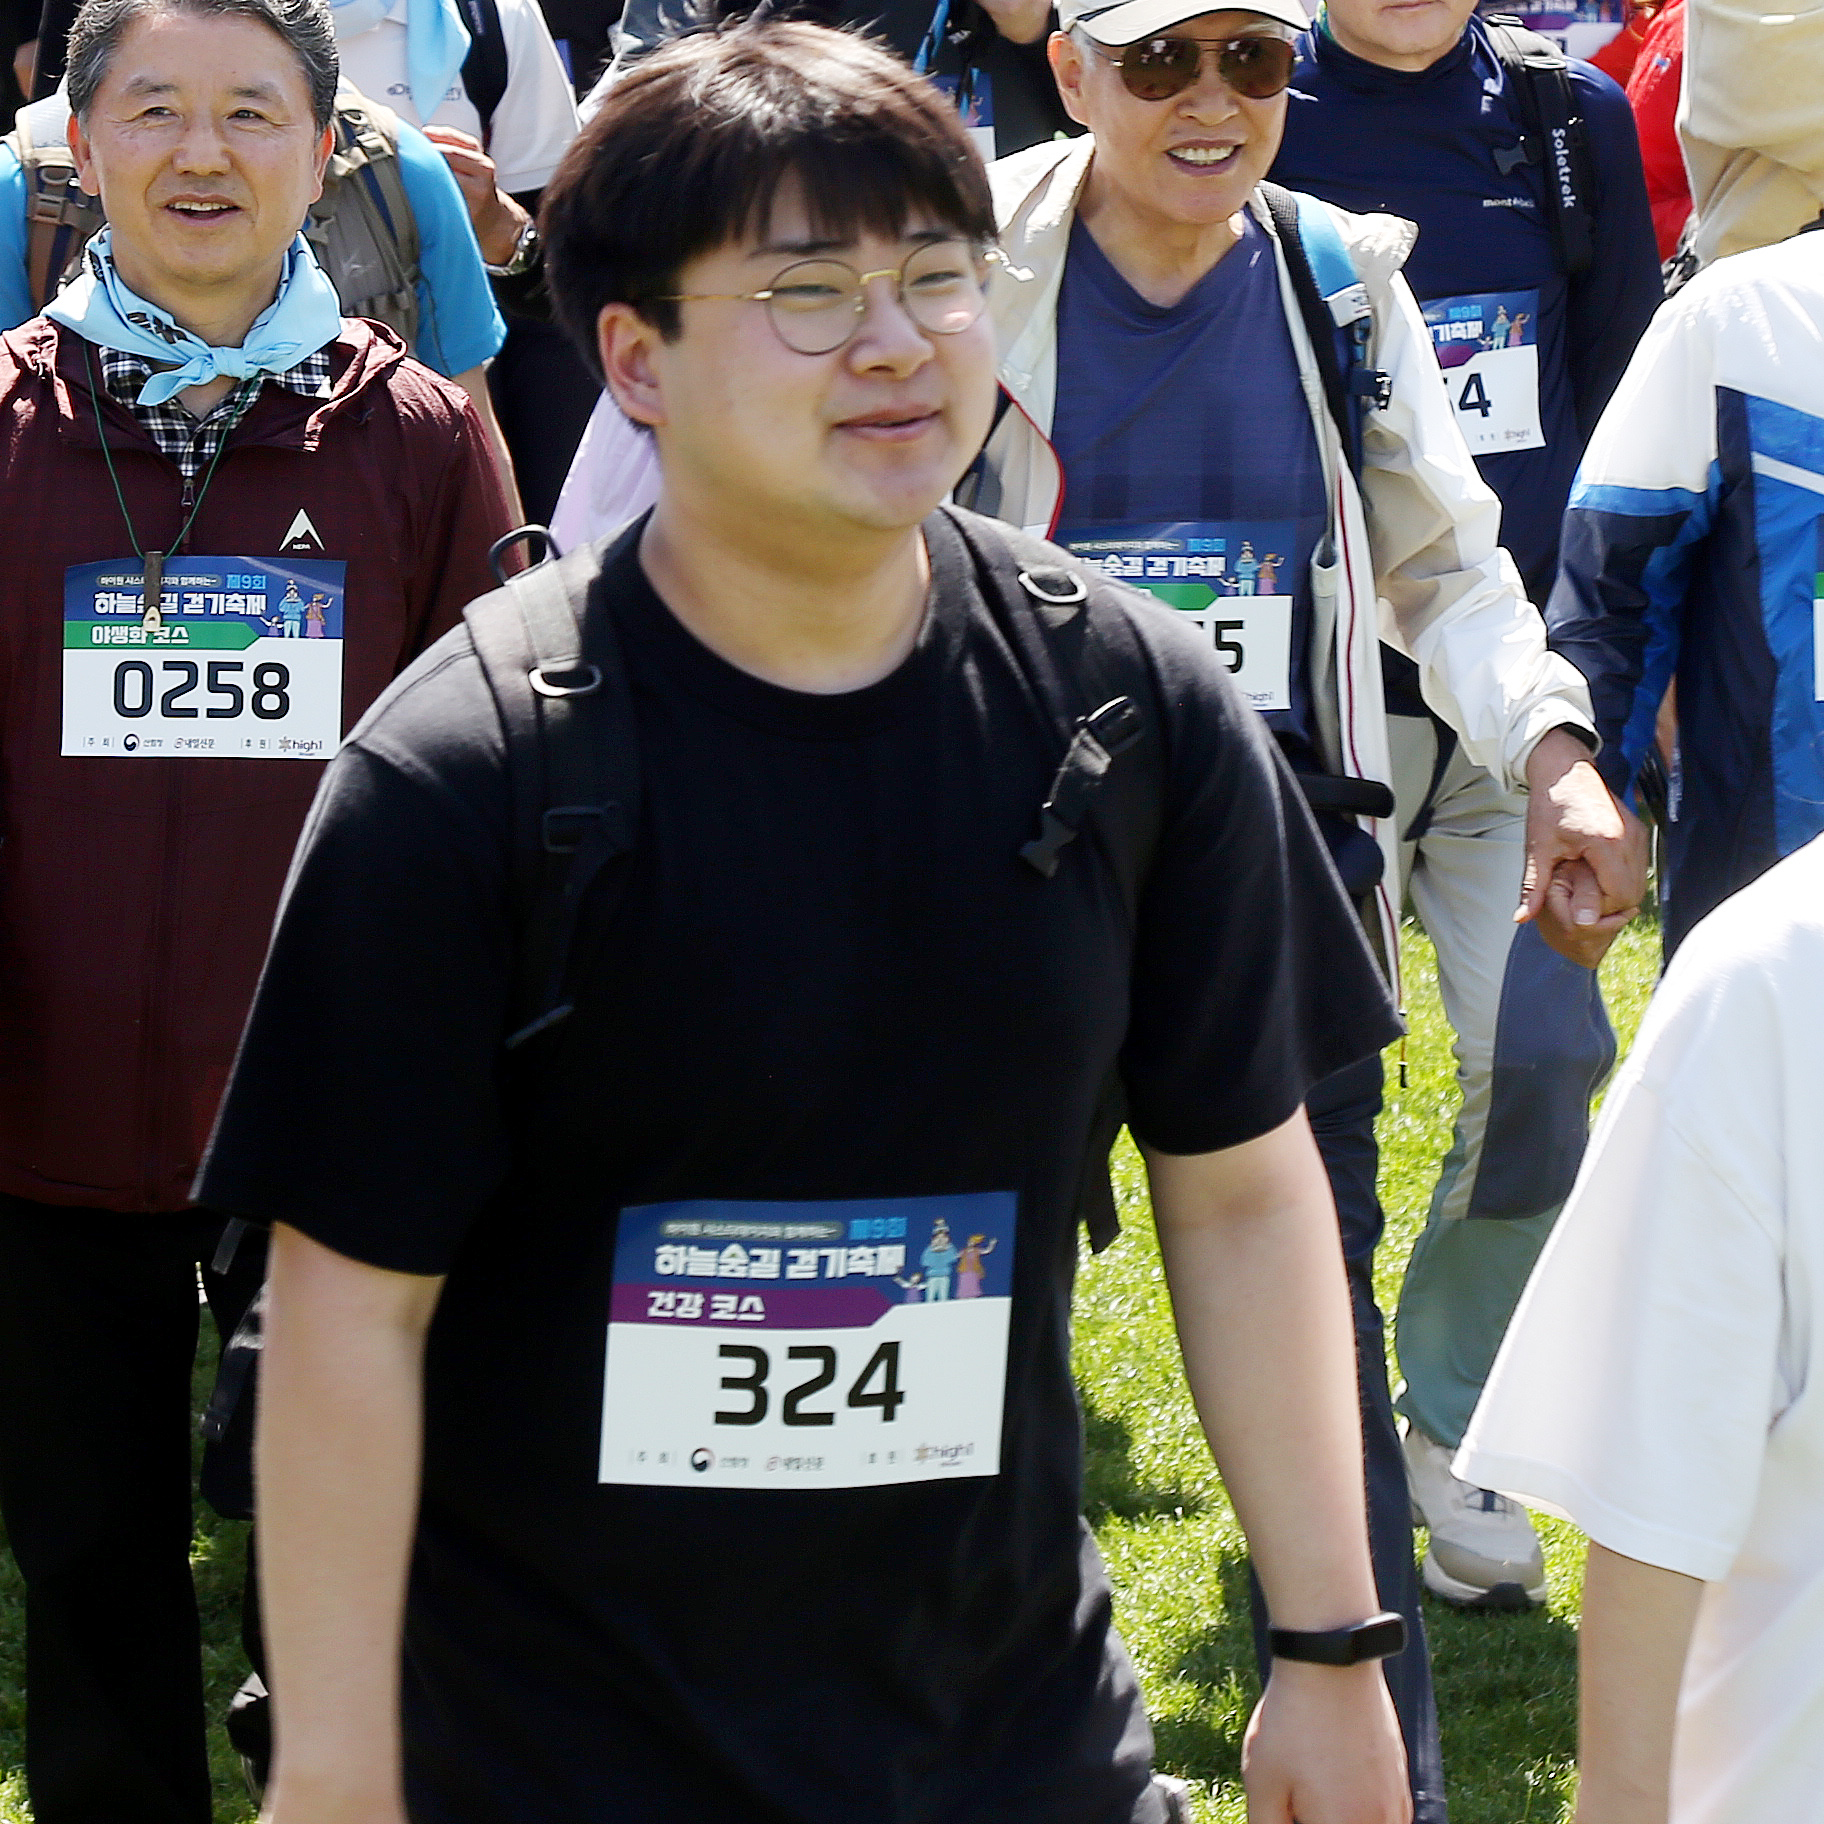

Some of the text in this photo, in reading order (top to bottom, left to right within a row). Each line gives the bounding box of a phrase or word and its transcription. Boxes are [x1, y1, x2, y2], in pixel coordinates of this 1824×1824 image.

[183, 592, 267, 616] 걷기축제
[91, 625, 190, 645] 야생화 코스
[114, 660, 290, 720] 0258
[292, 739, 323, 752] high1
[654, 1242, 907, 1279] 하늘숲길 걷기축제
[647, 1291, 766, 1322] 건강 코스
[714, 1340, 906, 1427] 324
